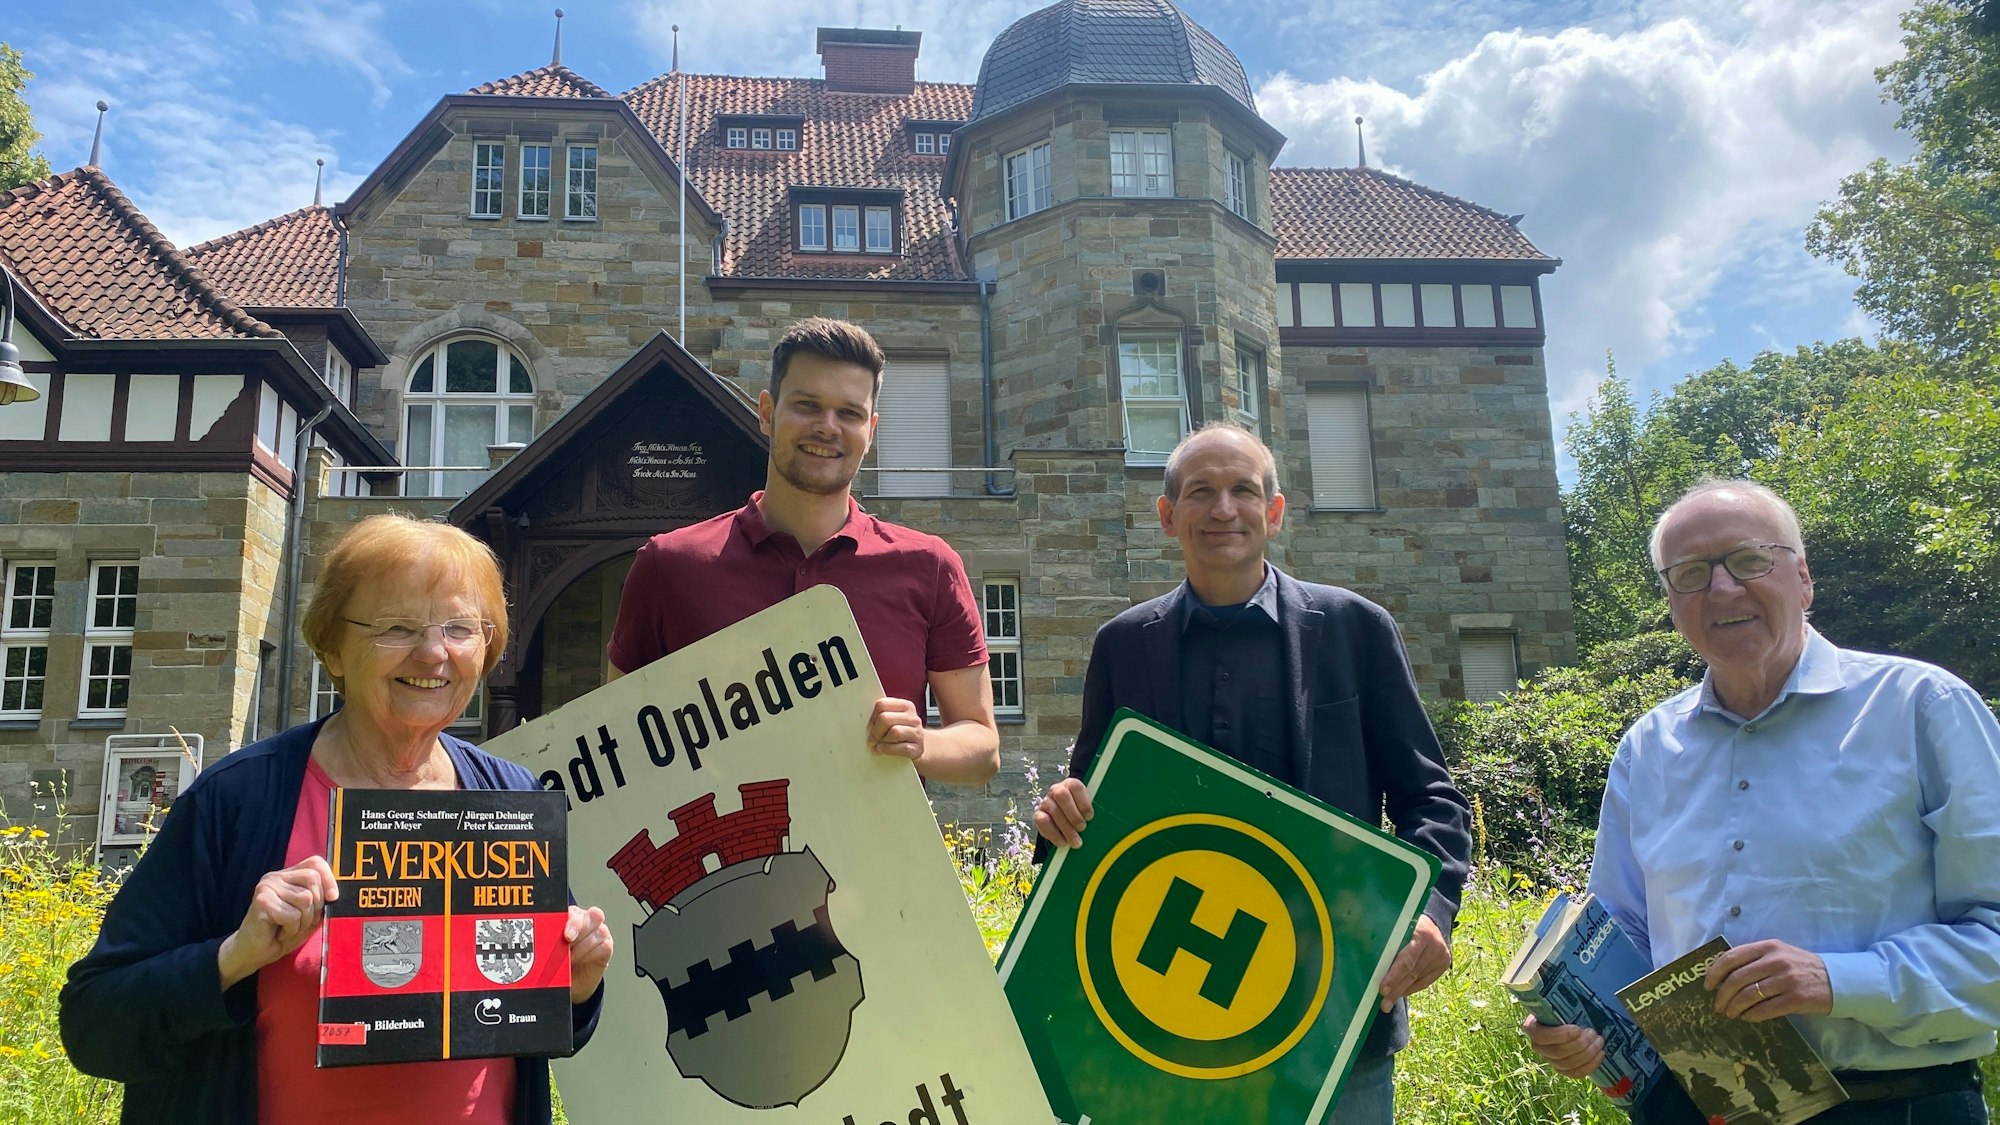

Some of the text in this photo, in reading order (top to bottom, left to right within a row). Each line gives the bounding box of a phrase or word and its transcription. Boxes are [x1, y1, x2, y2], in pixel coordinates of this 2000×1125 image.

[637, 635, 859, 771] Opladen
[361, 810, 385, 820] Hans
[387, 810, 415, 821] Georg
[416, 810, 459, 820] Schaffner
[465, 810, 494, 822] Jürgen
[495, 811, 534, 822] Dehniger
[361, 820, 534, 832] Lothar Meyer Peter Kaczmarek
[333, 840, 550, 881] LEVERKUSEN
[359, 885, 534, 908] GESTERN HEUTE
[1136, 876, 1268, 1010] H
[1580, 917, 1617, 965] Opladen
[374, 1018, 425, 1031] Bilderbuch
[508, 1013, 537, 1024] Braun
